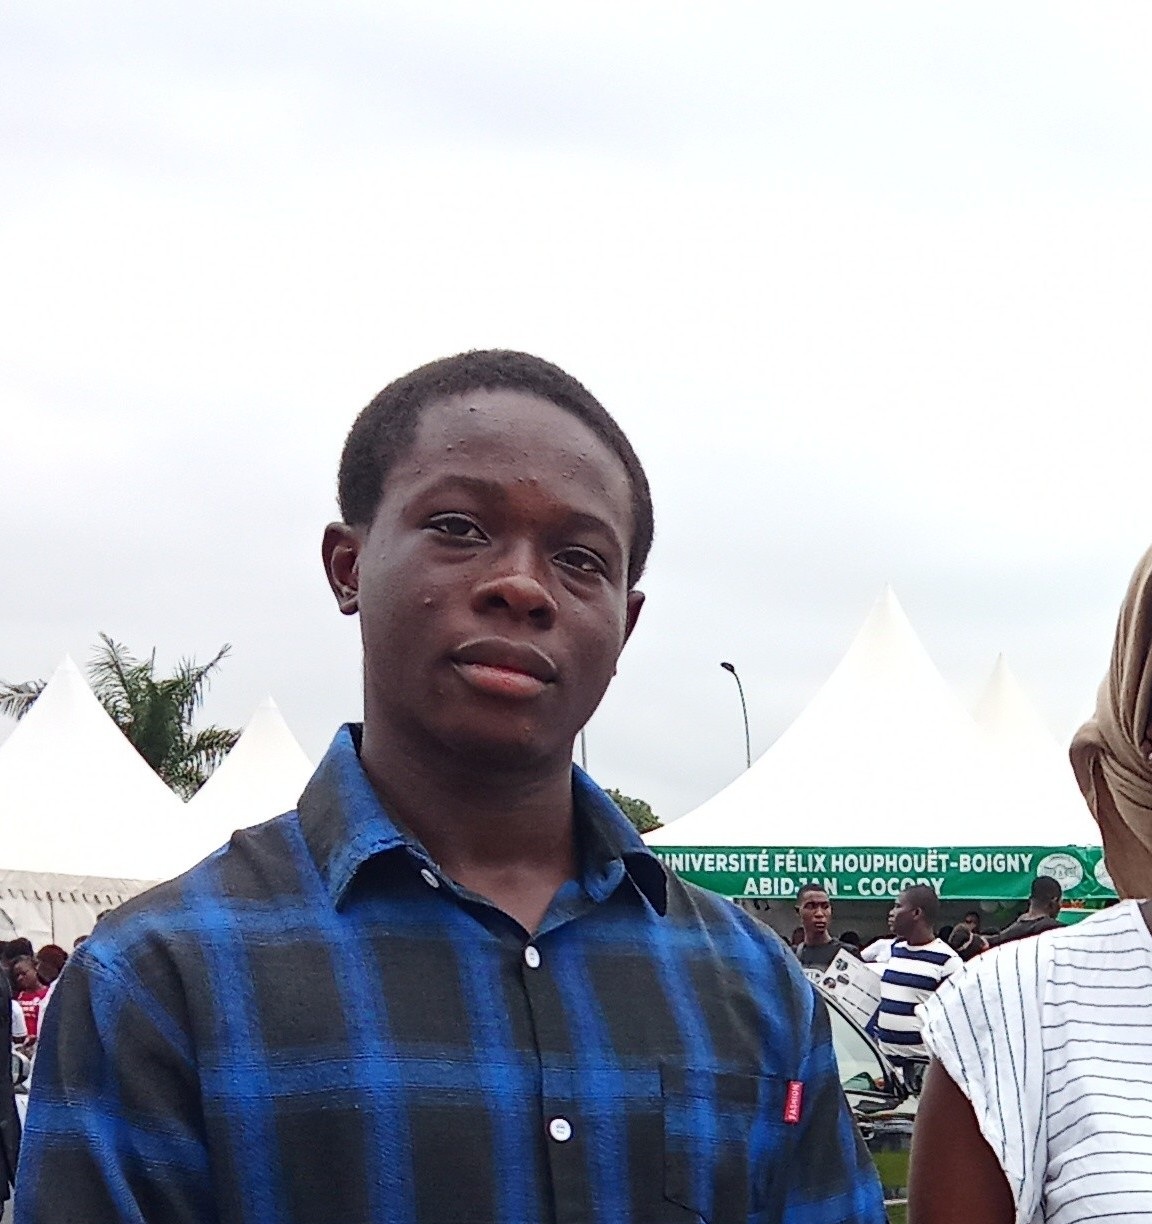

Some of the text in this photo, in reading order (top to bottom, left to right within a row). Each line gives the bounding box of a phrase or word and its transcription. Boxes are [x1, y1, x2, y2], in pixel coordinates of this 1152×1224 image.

[658, 849, 1034, 873] UNIVERSITÉ FÉLIX HOUPHOUËT-BOIGNY
[857, 877, 945, 896] COCY
